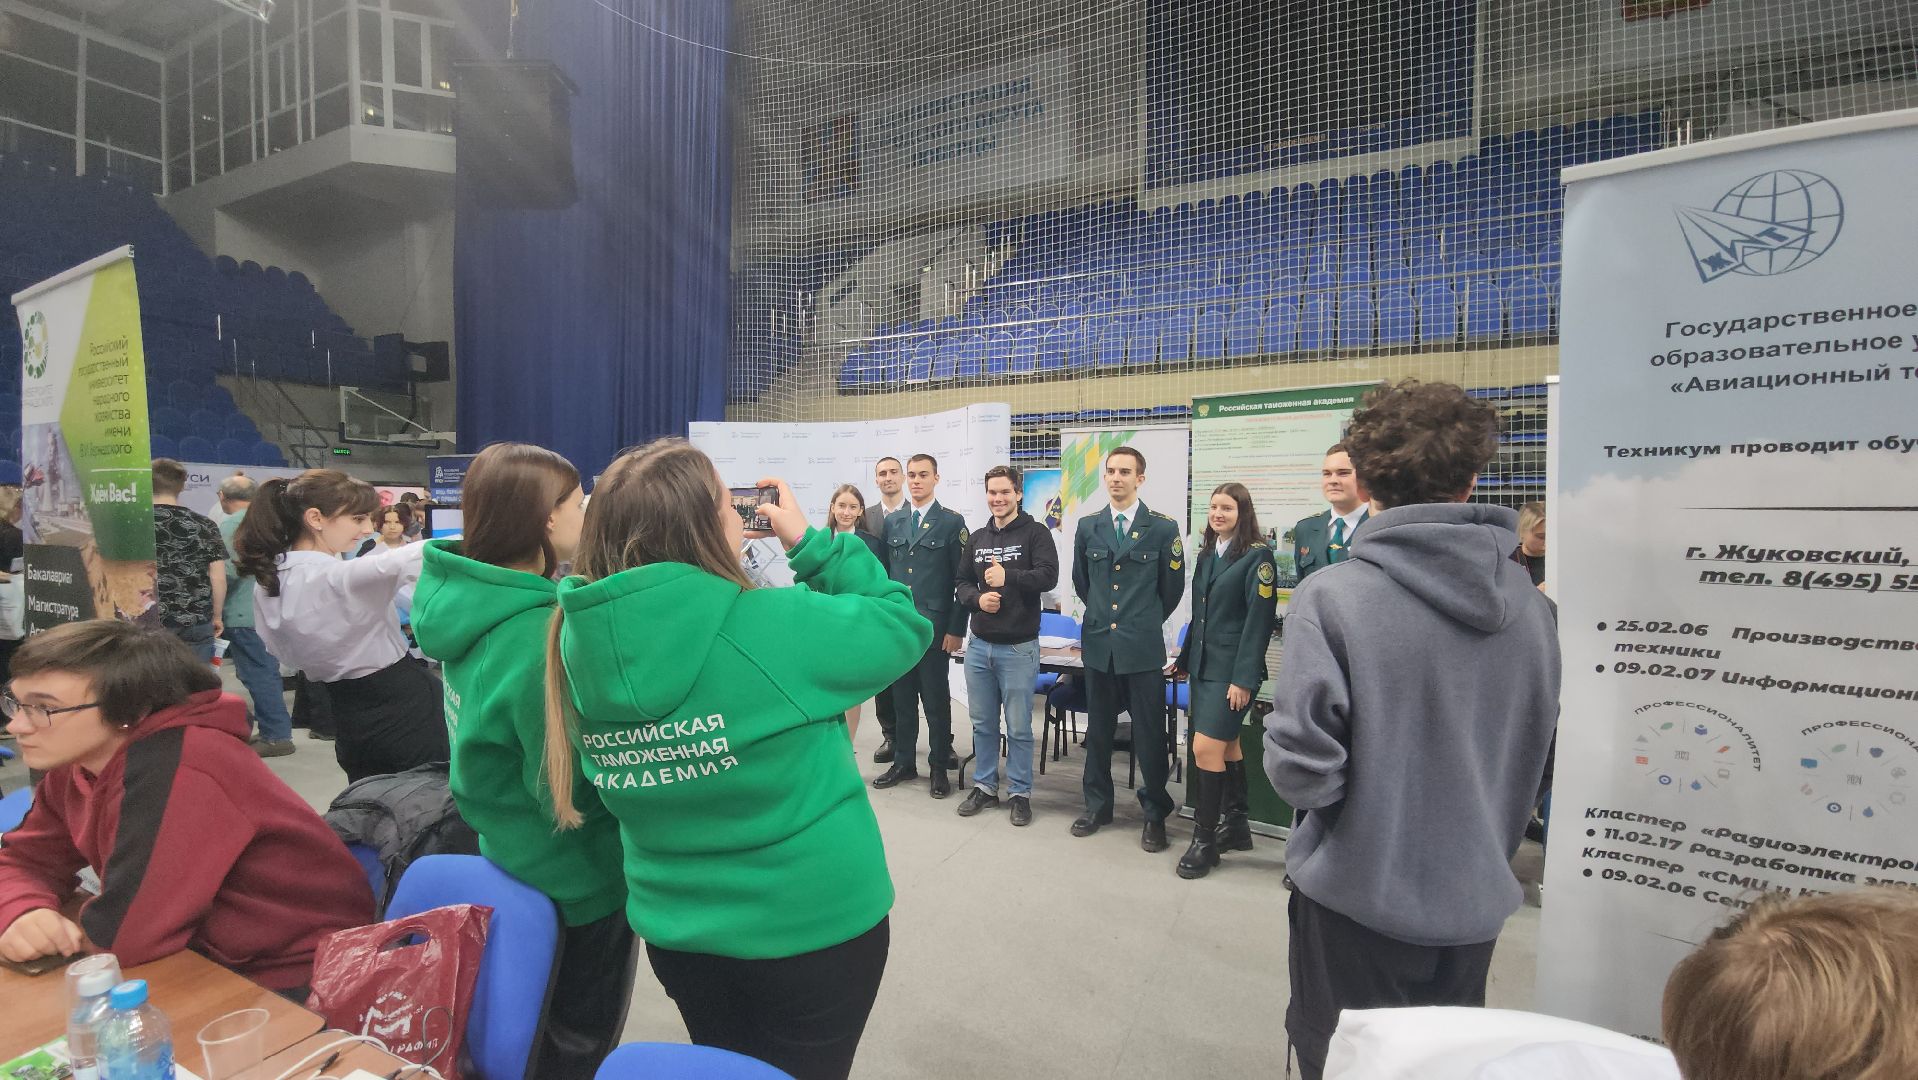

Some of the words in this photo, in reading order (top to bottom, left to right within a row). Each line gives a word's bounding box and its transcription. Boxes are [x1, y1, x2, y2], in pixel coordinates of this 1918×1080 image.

[1665, 303, 1918, 339] Государственное
[1650, 335, 1904, 368] образовательное
[1670, 363, 1891, 394] «Авиационный
[1219, 403, 1262, 413] Российская
[1264, 400, 1311, 410] таможенная
[1313, 396, 1355, 406] академия
[1604, 443, 1721, 459] Техникум
[1730, 439, 1860, 457] проводит
[109, 482, 137, 503] Вас!
[1715, 543, 1910, 567] Жуковский,
[1699, 569, 1773, 586] тел.
[1782, 570, 1882, 593] 8(495)
[28, 595, 79, 620] Магистратура
[1614, 620, 1709, 637] 25.02.06
[1732, 627, 1918, 651] Производств
[1614, 641, 1721, 660] техники
[1613, 661, 1716, 682] 09.02.07
[582, 713, 726, 749] РОССИЙСКАЯ
[1634, 700, 1761, 772] ПРОФЕССИОНАЛИТЕТ
[591, 737, 730, 768] ТАМОЖЕННАЯ
[593, 755, 739, 790] АКАДЕМИЯ
[1585, 807, 1687, 833] Кластер
[1701, 827, 1918, 872] «Радиоэлектро
[1582, 847, 1684, 874] Кластер
[1604, 828, 1683, 850] 11.02.17
[1690, 841, 1856, 884] Разработка
[1601, 868, 1696, 898] 09.02.06
